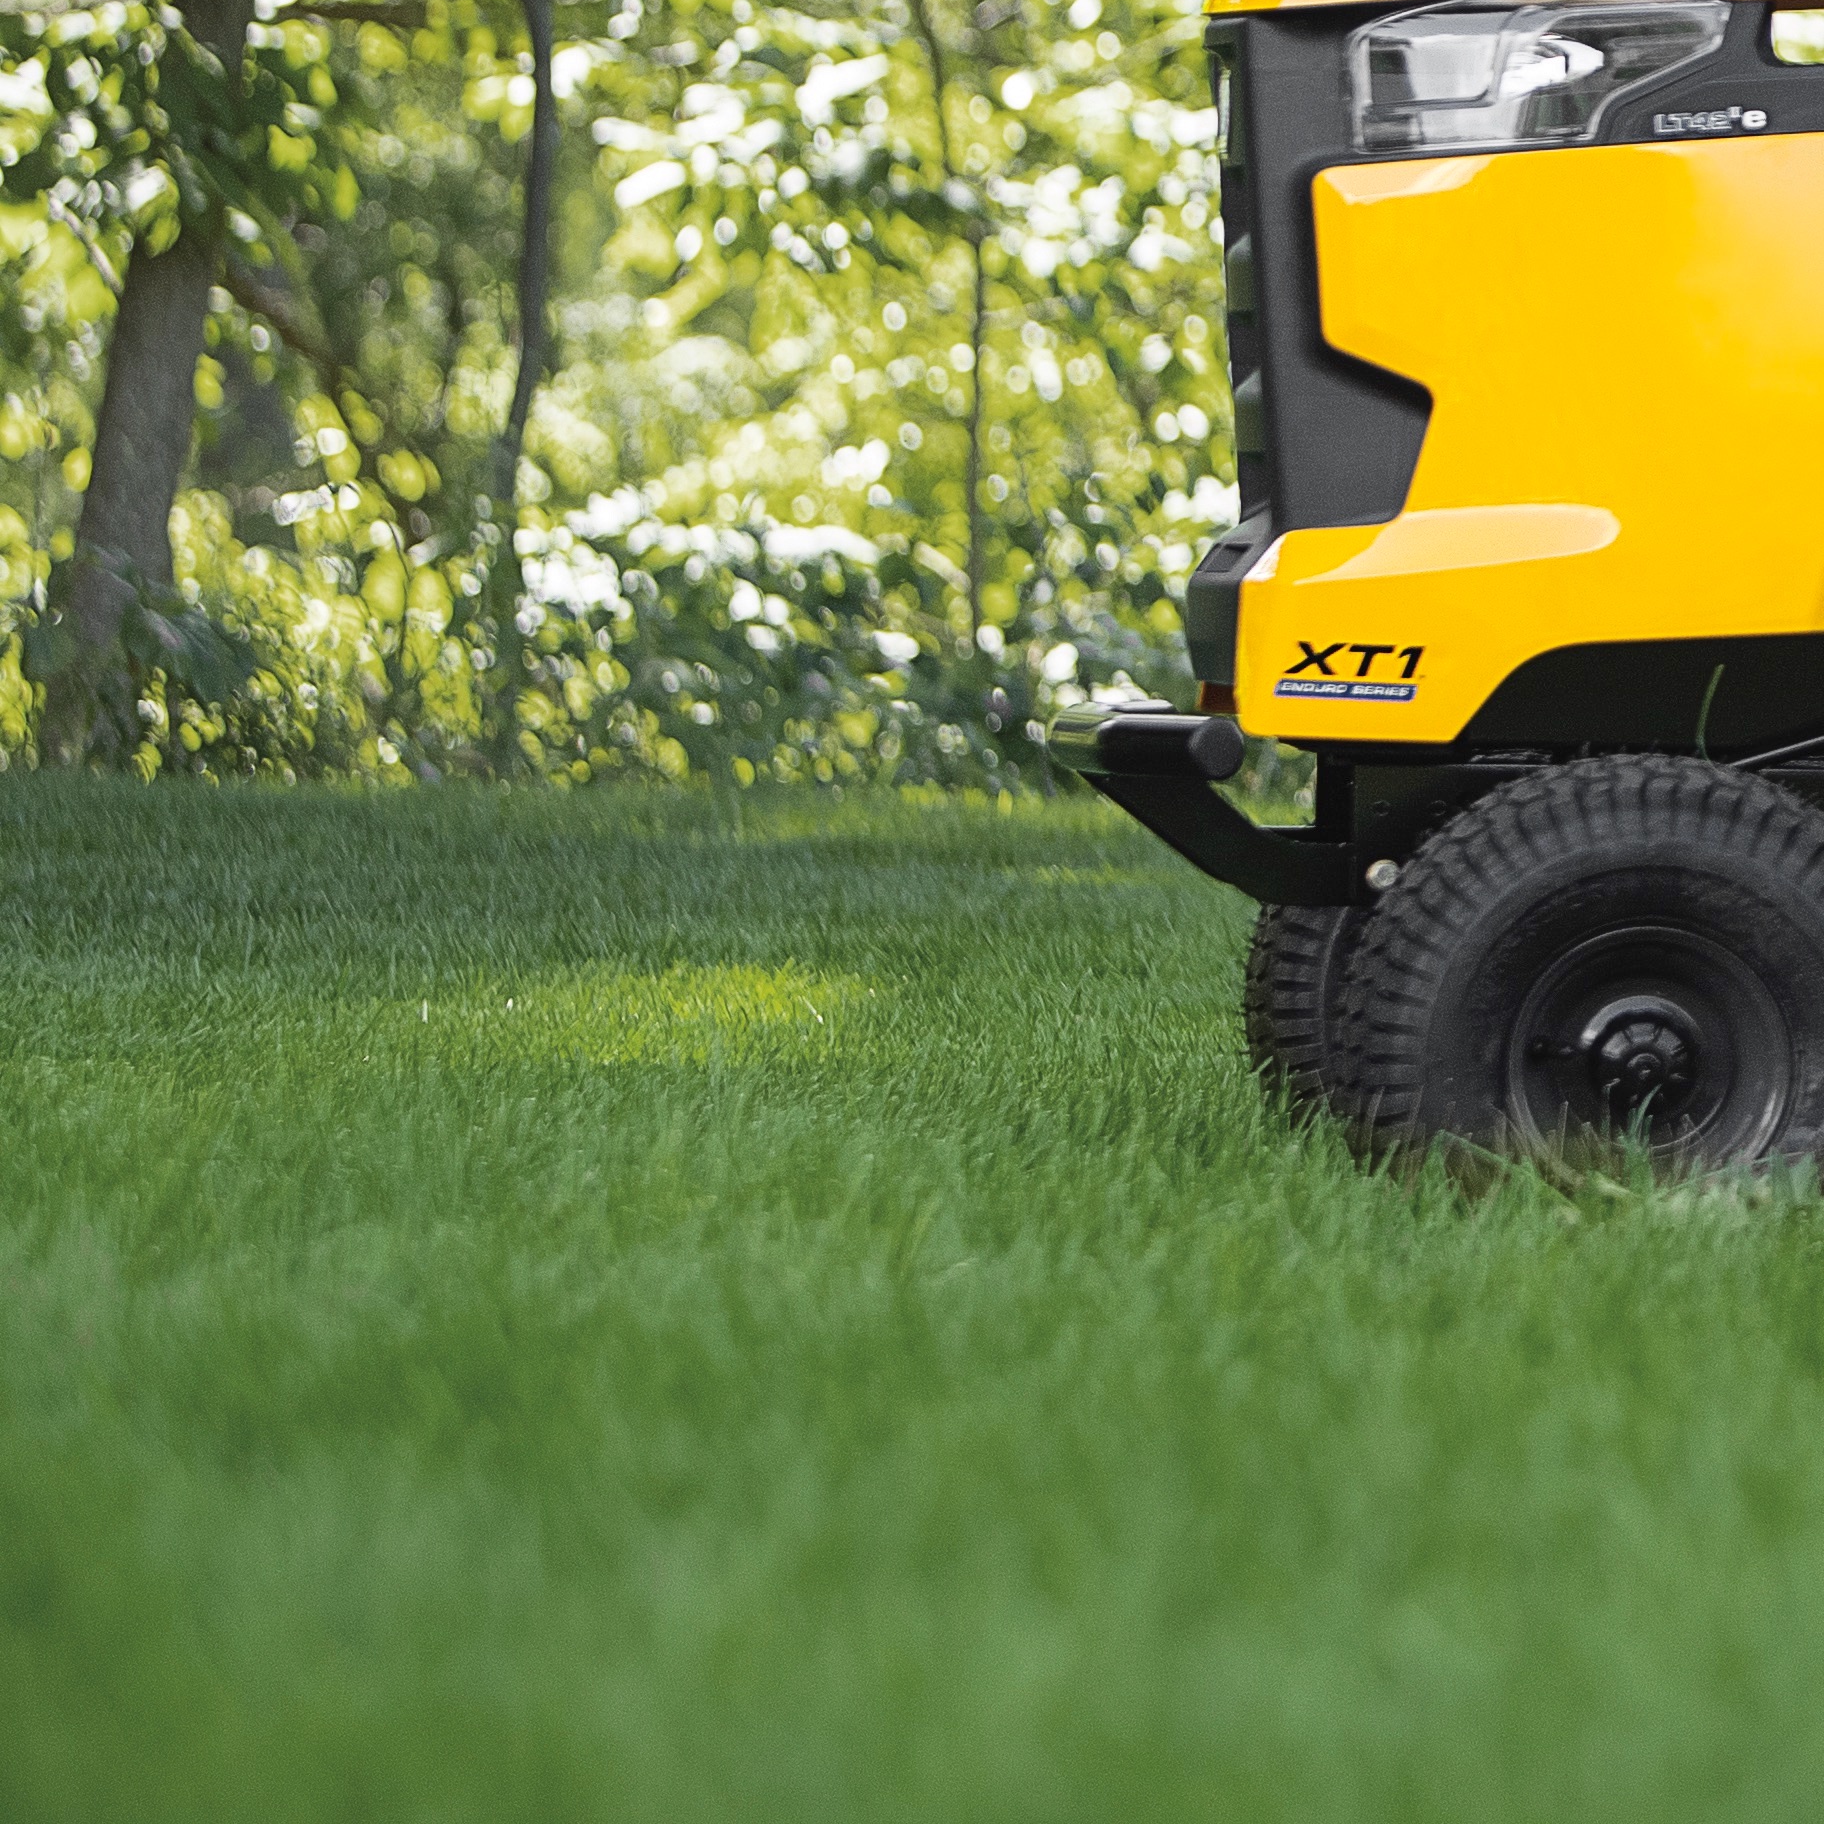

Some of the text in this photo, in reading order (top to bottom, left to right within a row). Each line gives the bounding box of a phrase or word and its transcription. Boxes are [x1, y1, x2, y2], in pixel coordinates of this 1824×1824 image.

[1283, 641, 1424, 678] XT1
[1281, 682, 1410, 697] ENDURO SERIES
